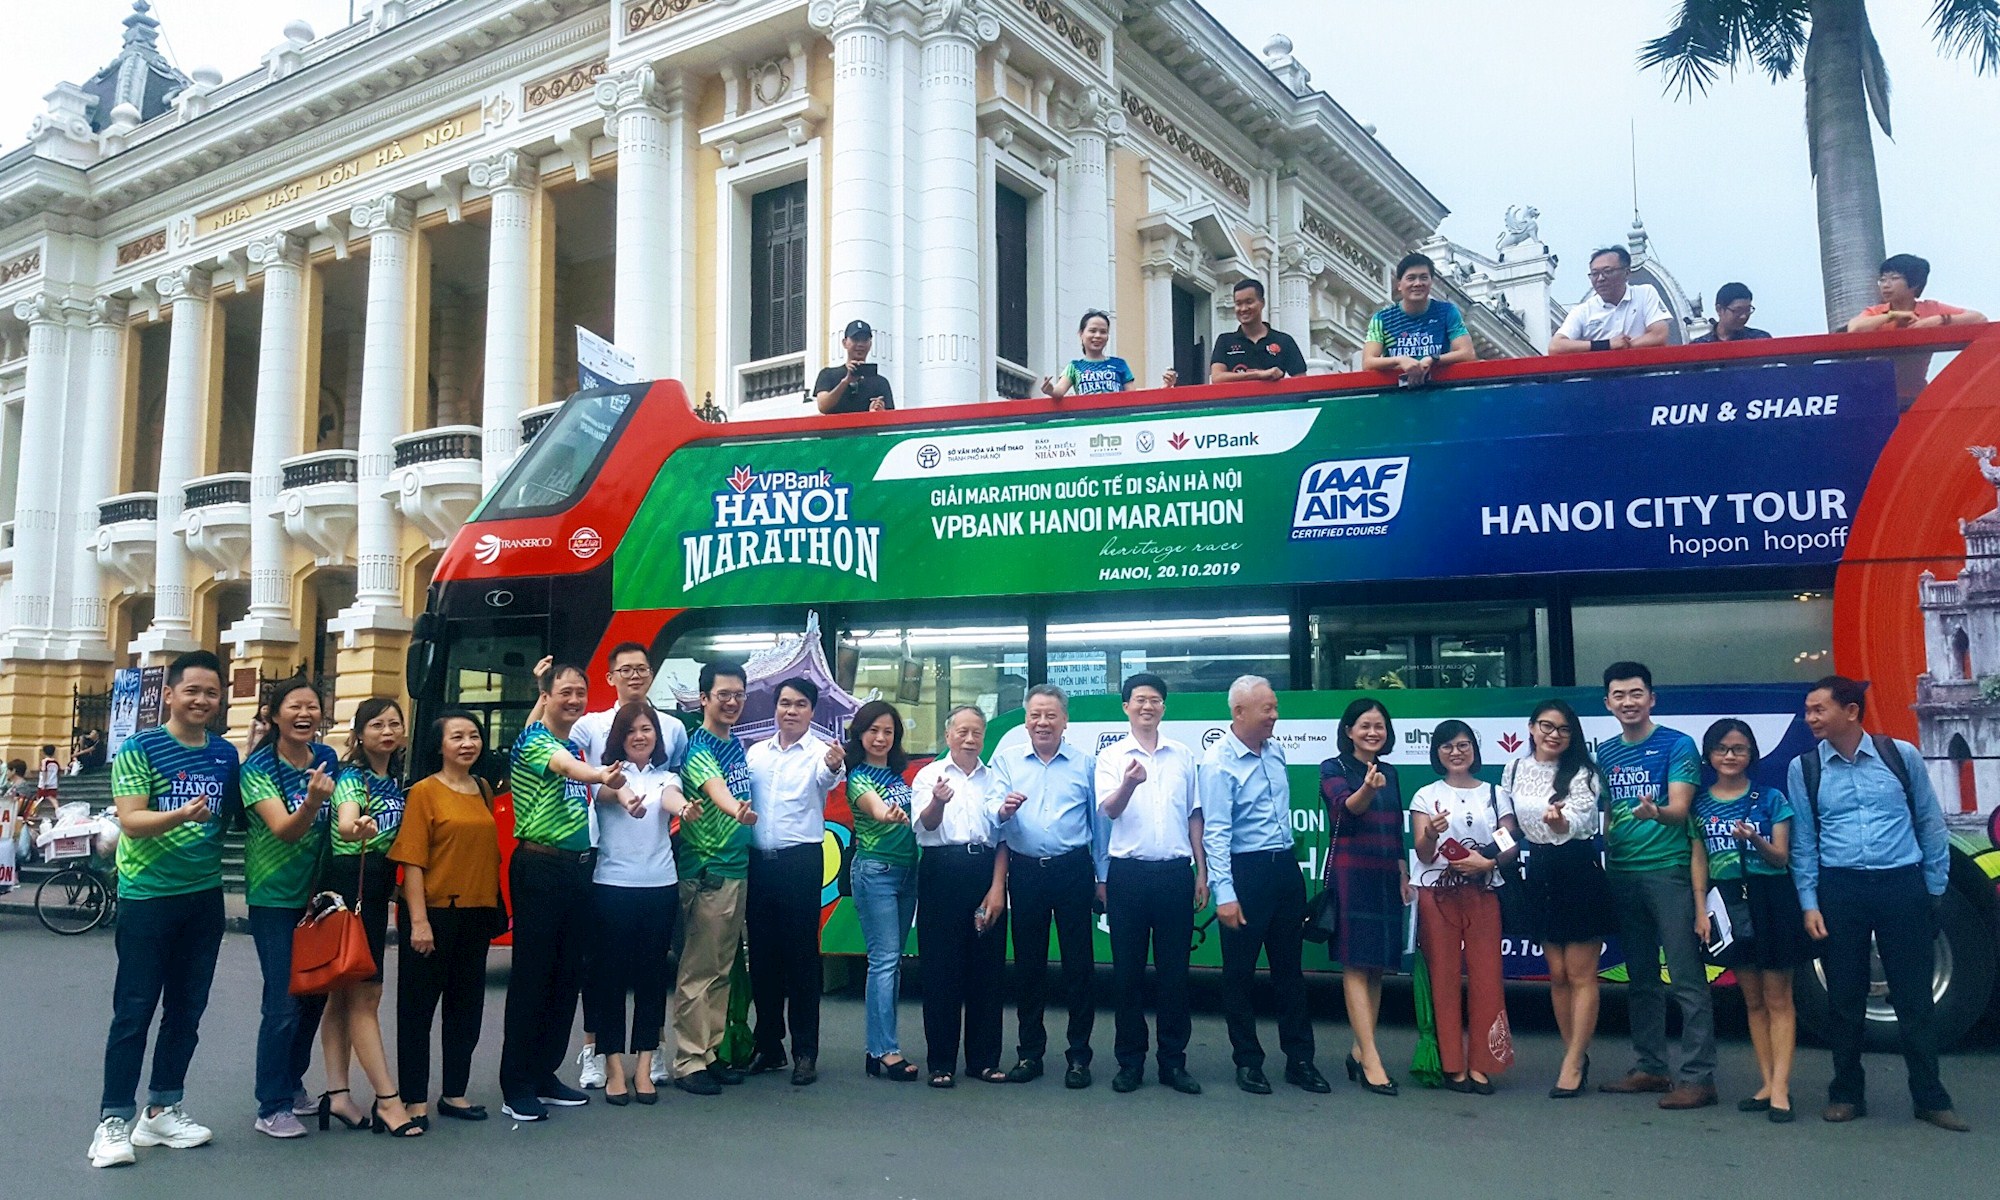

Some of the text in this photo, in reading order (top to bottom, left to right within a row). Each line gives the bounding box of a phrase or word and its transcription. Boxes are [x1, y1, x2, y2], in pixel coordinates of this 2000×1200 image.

[213, 120, 463, 230] NHÀ HÁT LỚN HÀ NỘI
[1388, 345, 1443, 358] MARATHON
[1397, 335, 1434, 347] HANOI
[1081, 370, 1116, 382] HANOI
[1650, 395, 1839, 426] RUN & SHARE
[1194, 431, 1260, 449] VPBank
[759, 470, 831, 491] VPBank
[930, 466, 1243, 508] GIẢI MARATHON QUỐC TẾ DI SẢN HÀ NỘI
[1306, 463, 1404, 493] IAAF
[715, 487, 849, 528] HANOI
[1302, 491, 1390, 521] AIMS
[1481, 488, 1848, 536] HANOI CITY TOUR
[931, 498, 1244, 540] VPBANK HANOI MARATHON
[500, 537, 553, 549] TRANSERCO
[1291, 525, 1388, 539] CERTIFIED COURSE
[1669, 525, 1848, 559] hopon hopoff
[682, 527, 880, 593] MARATHON
[1099, 537, 1244, 564] heritage race
[1099, 562, 1241, 582] HANOI, 20.10.2019
[1282, 734, 1293, 742] VÀ
[171, 780, 223, 796] HANOI
[1609, 770, 1650, 786] HANOI
